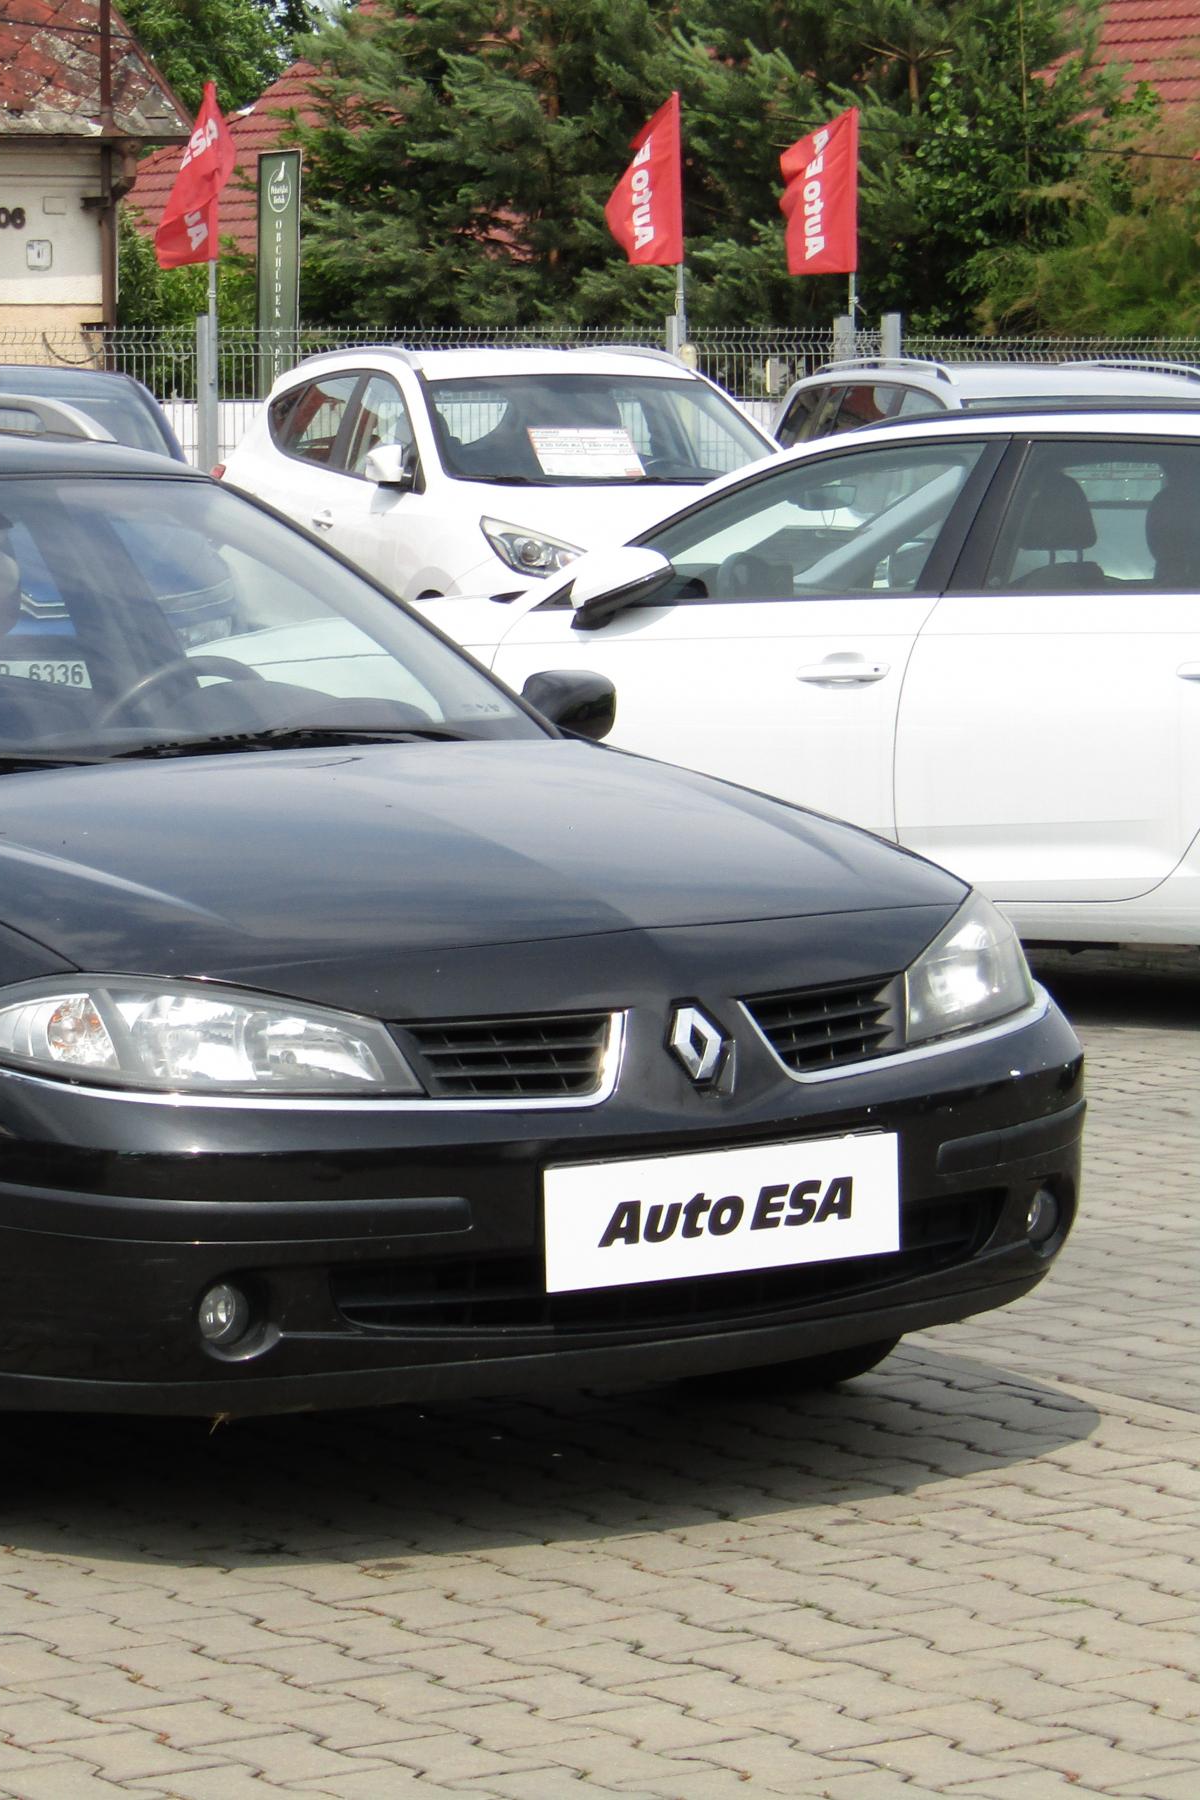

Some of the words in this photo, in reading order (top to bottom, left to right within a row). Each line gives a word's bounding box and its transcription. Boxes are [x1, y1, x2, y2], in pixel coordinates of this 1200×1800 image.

[29, 663, 84, 684] 6336
[597, 1192, 744, 1248] Auto
[750, 1175, 854, 1231] ESA
